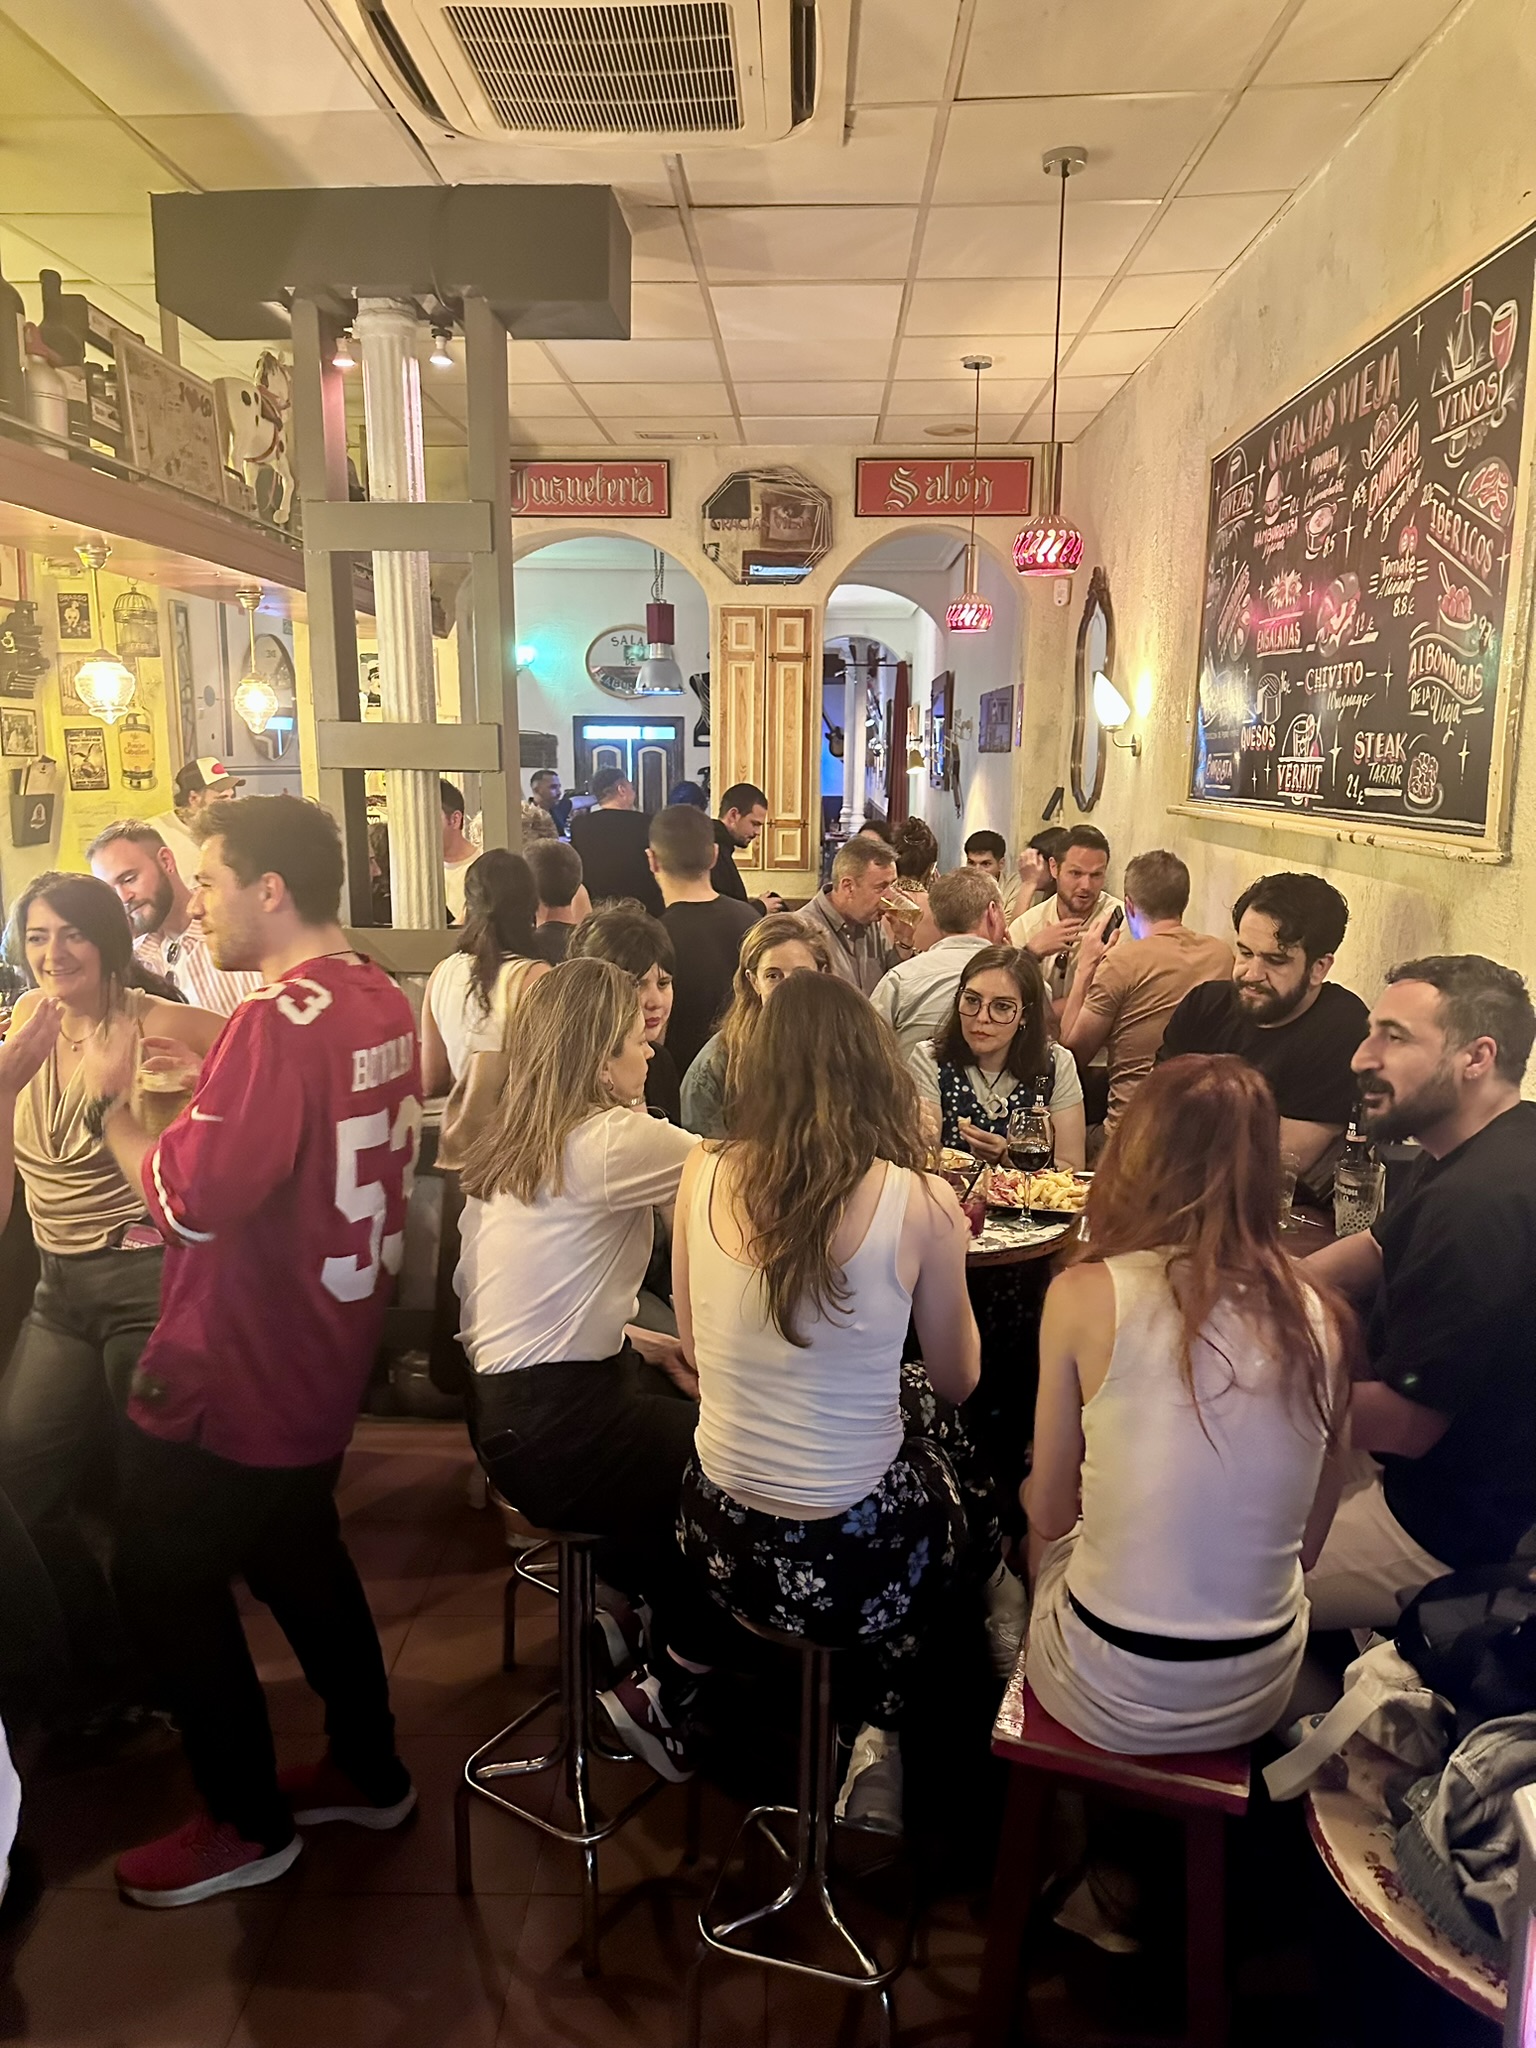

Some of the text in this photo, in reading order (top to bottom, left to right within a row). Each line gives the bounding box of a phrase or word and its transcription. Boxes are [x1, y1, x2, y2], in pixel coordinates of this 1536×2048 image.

[1339, 346, 1400, 424] VIEJA
[1438, 371, 1498, 430] VINOS
[884, 463, 994, 510] Salón
[1430, 499, 1494, 574] IBERICOS
[1381, 551, 1416, 579] Tomate
[611, 635, 645, 647] SALA
[1256, 621, 1301, 652] ENSALADAS
[1305, 660, 1364, 693] CHIVITO
[1411, 687, 1421, 711] DE
[1421, 685, 1431, 706] LA
[1241, 724, 1276, 751] QUESOS
[1354, 731, 1408, 762] STEAK
[1277, 763, 1323, 792] VERMUT
[1368, 762, 1403, 785] TARTAR
